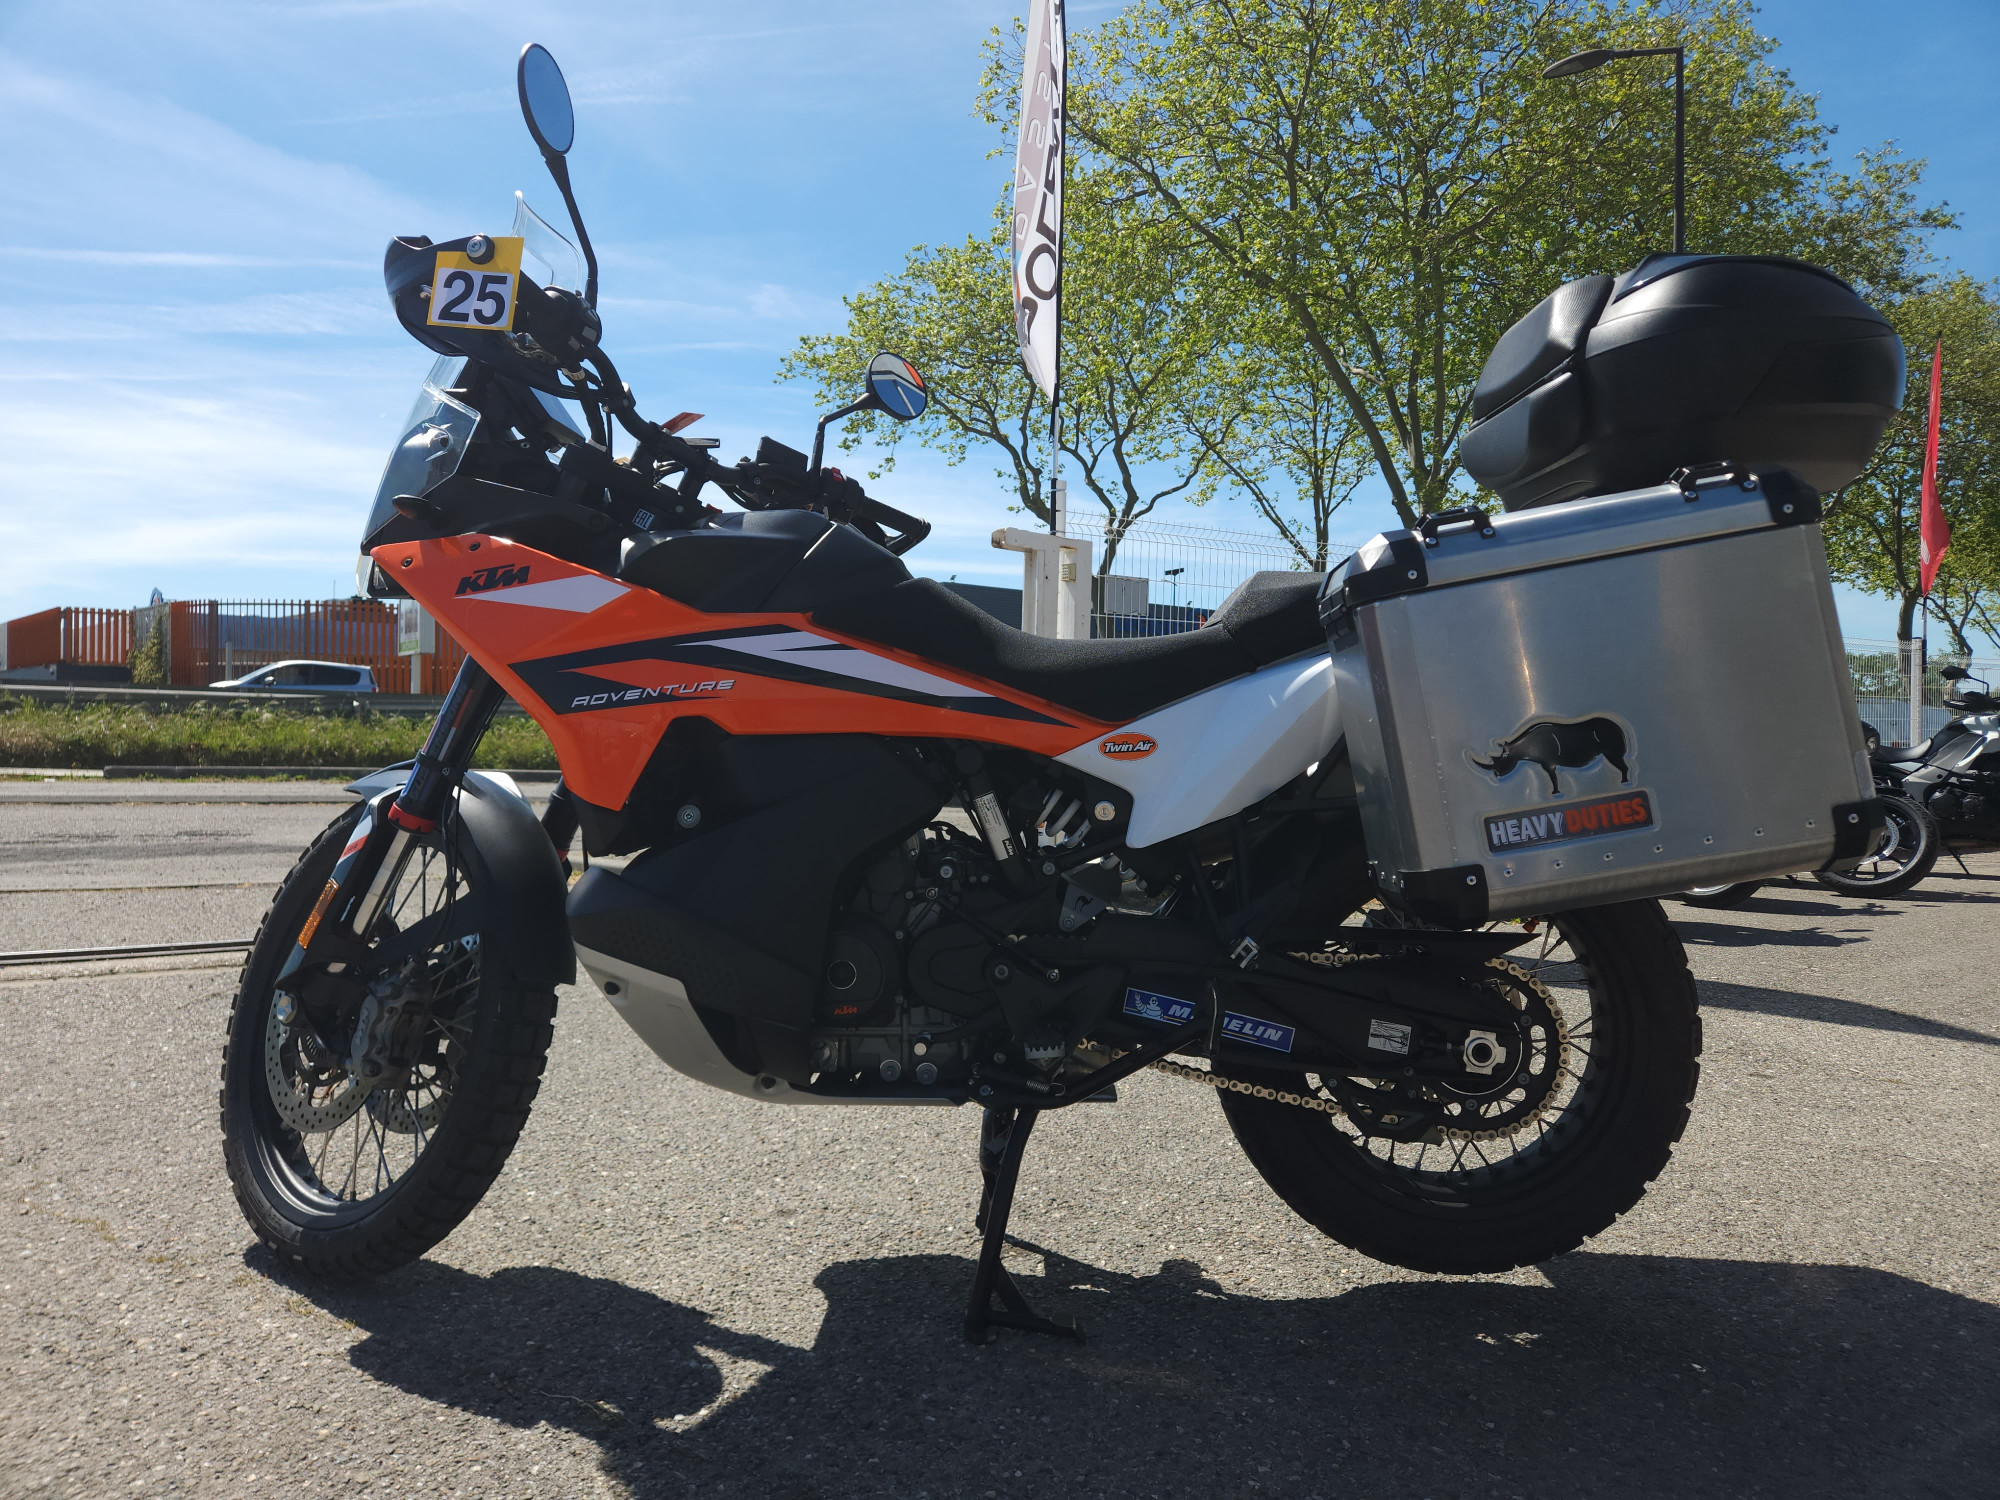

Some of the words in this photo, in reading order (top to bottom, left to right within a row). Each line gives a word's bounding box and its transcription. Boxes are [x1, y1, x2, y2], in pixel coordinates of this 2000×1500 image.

[438, 270, 508, 325] 25
[633, 510, 653, 529] EAC
[454, 563, 531, 595] KTM
[571, 679, 737, 708] ADVENTURE
[1104, 742, 1133, 753] Twin
[1135, 740, 1154, 752] Air
[1168, 1004, 1284, 1042] MELIN
